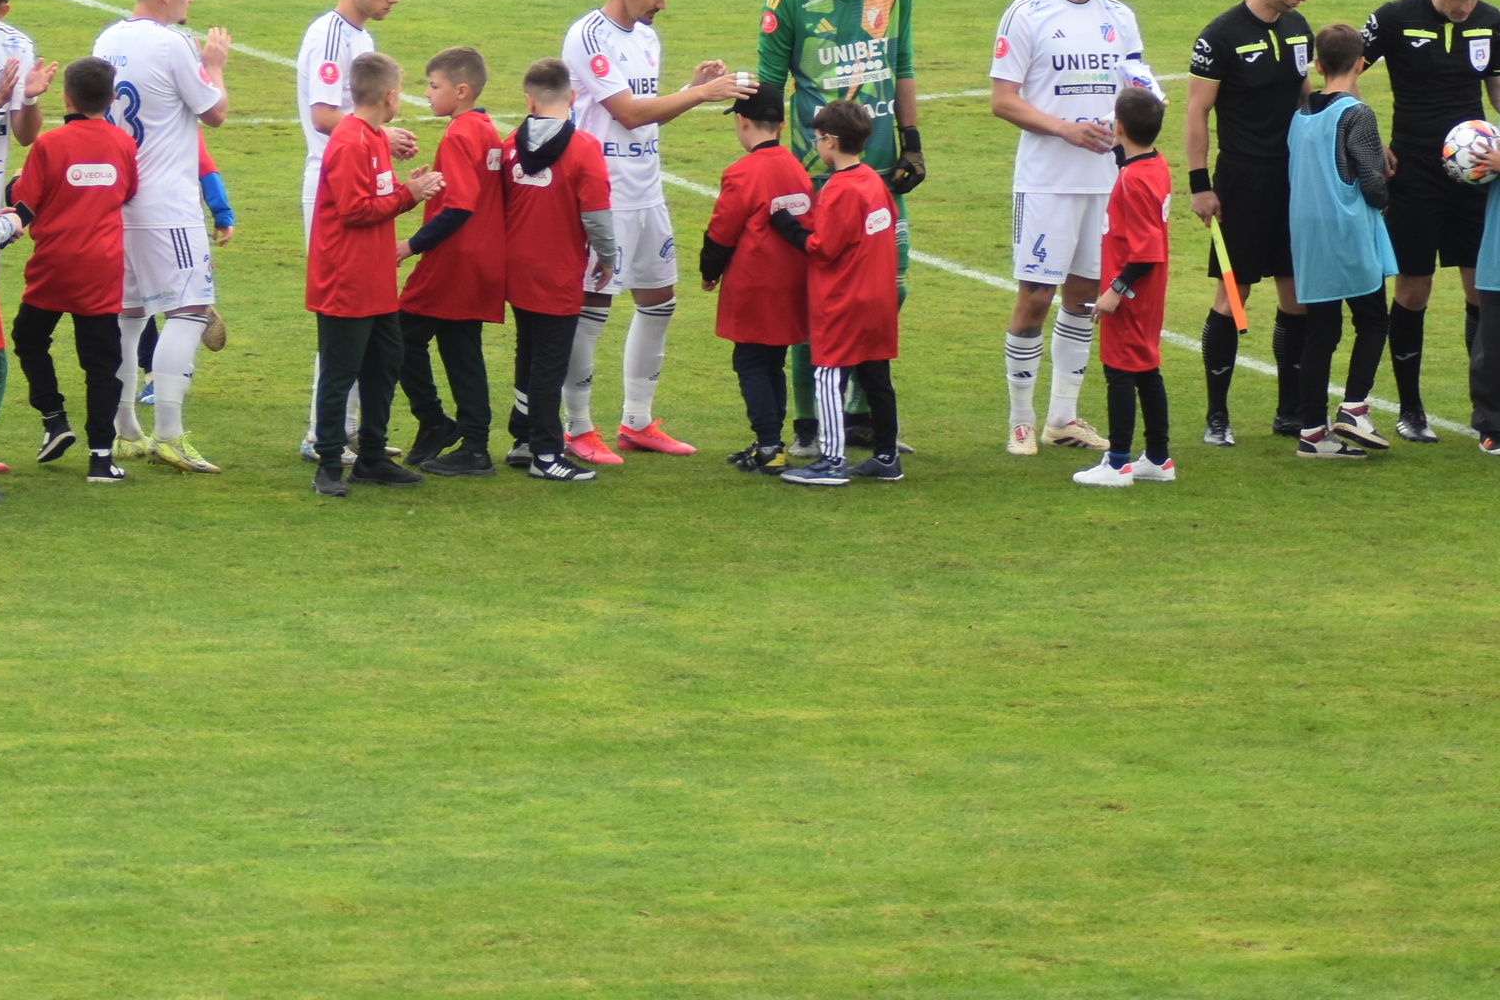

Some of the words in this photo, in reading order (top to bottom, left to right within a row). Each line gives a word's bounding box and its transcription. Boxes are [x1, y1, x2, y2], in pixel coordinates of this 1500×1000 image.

[819, 37, 889, 66] UNIBET
[1052, 53, 1120, 71] UNIBET
[83, 171, 113, 179] VEOLIA
[1032, 233, 1047, 263] 4
